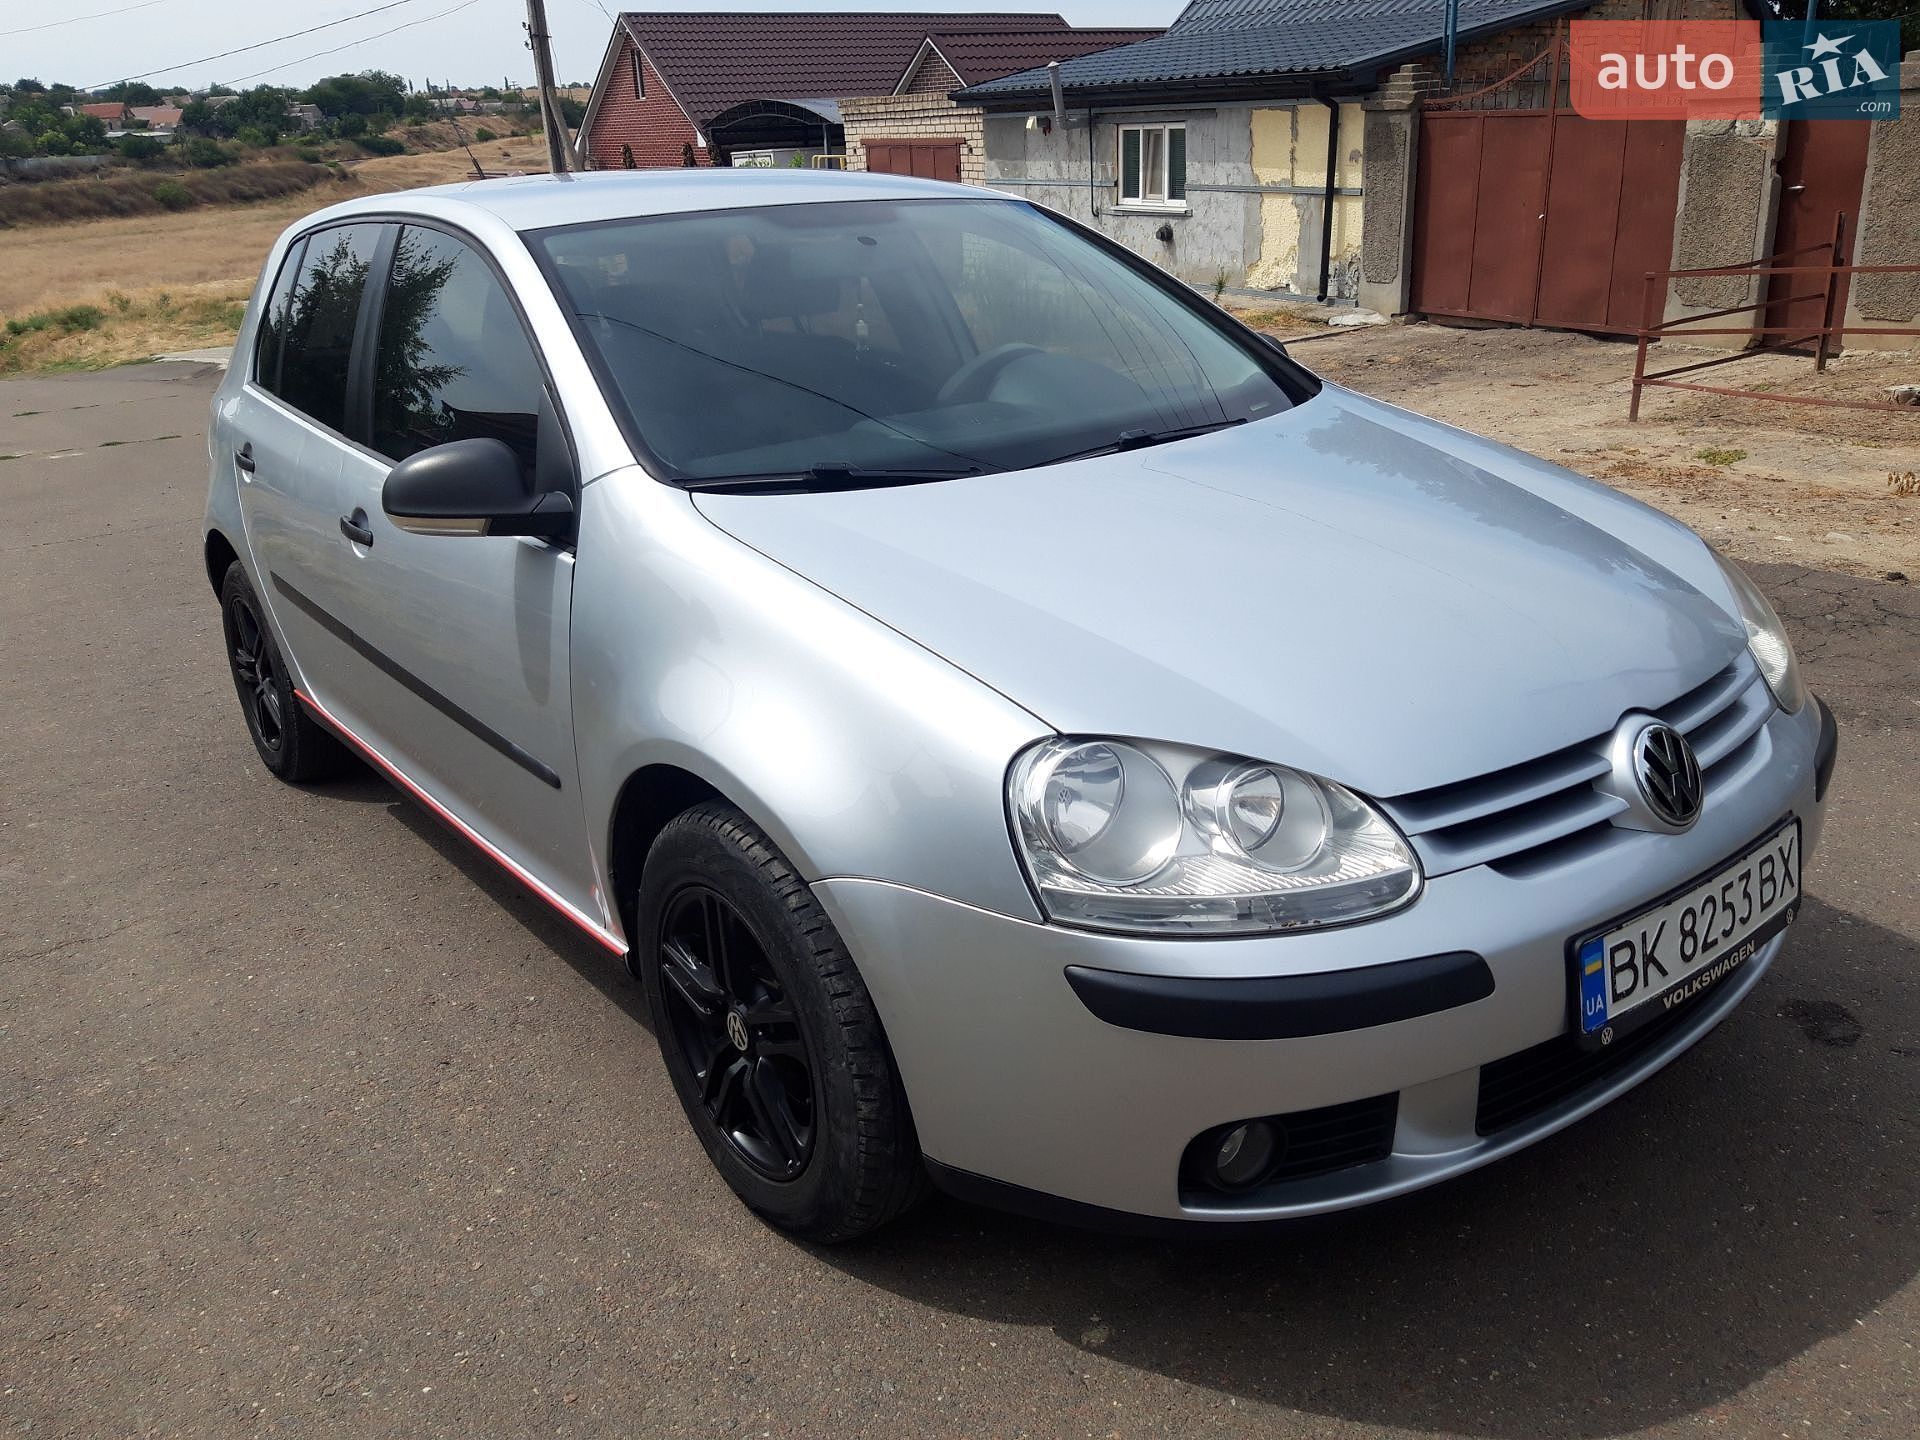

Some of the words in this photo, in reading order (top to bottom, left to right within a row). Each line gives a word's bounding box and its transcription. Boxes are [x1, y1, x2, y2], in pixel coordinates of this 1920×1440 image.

[1609, 920, 1669, 1004] BK
[1679, 868, 1753, 964] 8253
[1758, 836, 1795, 913] BX
[1586, 993, 1605, 1017] UA
[1663, 940, 1756, 1010] VOLKSWAGEN
